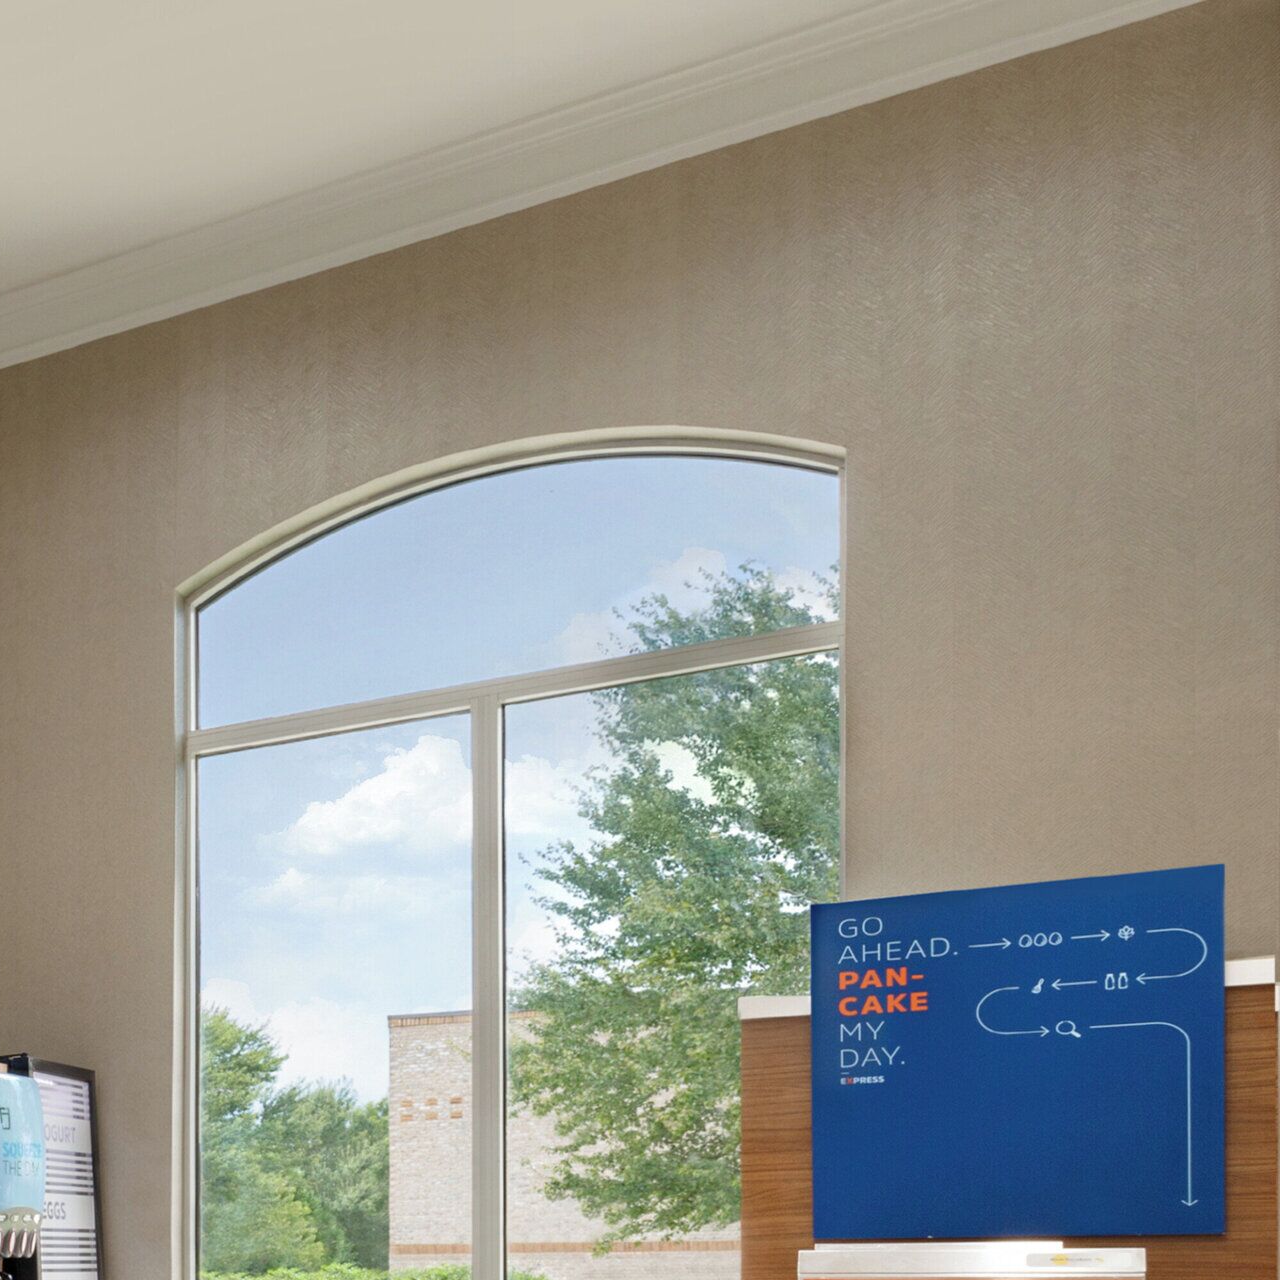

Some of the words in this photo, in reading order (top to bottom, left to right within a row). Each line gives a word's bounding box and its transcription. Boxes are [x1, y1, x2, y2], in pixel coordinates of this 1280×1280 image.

[838, 916, 884, 939] GO
[837, 937, 958, 965] AHEAD.
[838, 966, 925, 991] PAN-
[838, 991, 929, 1017] CAKE
[840, 1020, 886, 1043] MY
[840, 1045, 906, 1069] DAY.
[840, 1075, 886, 1086] EXPRESS
[44, 1123, 76, 1144] OGURT
[3, 1159, 22, 1177] THE
